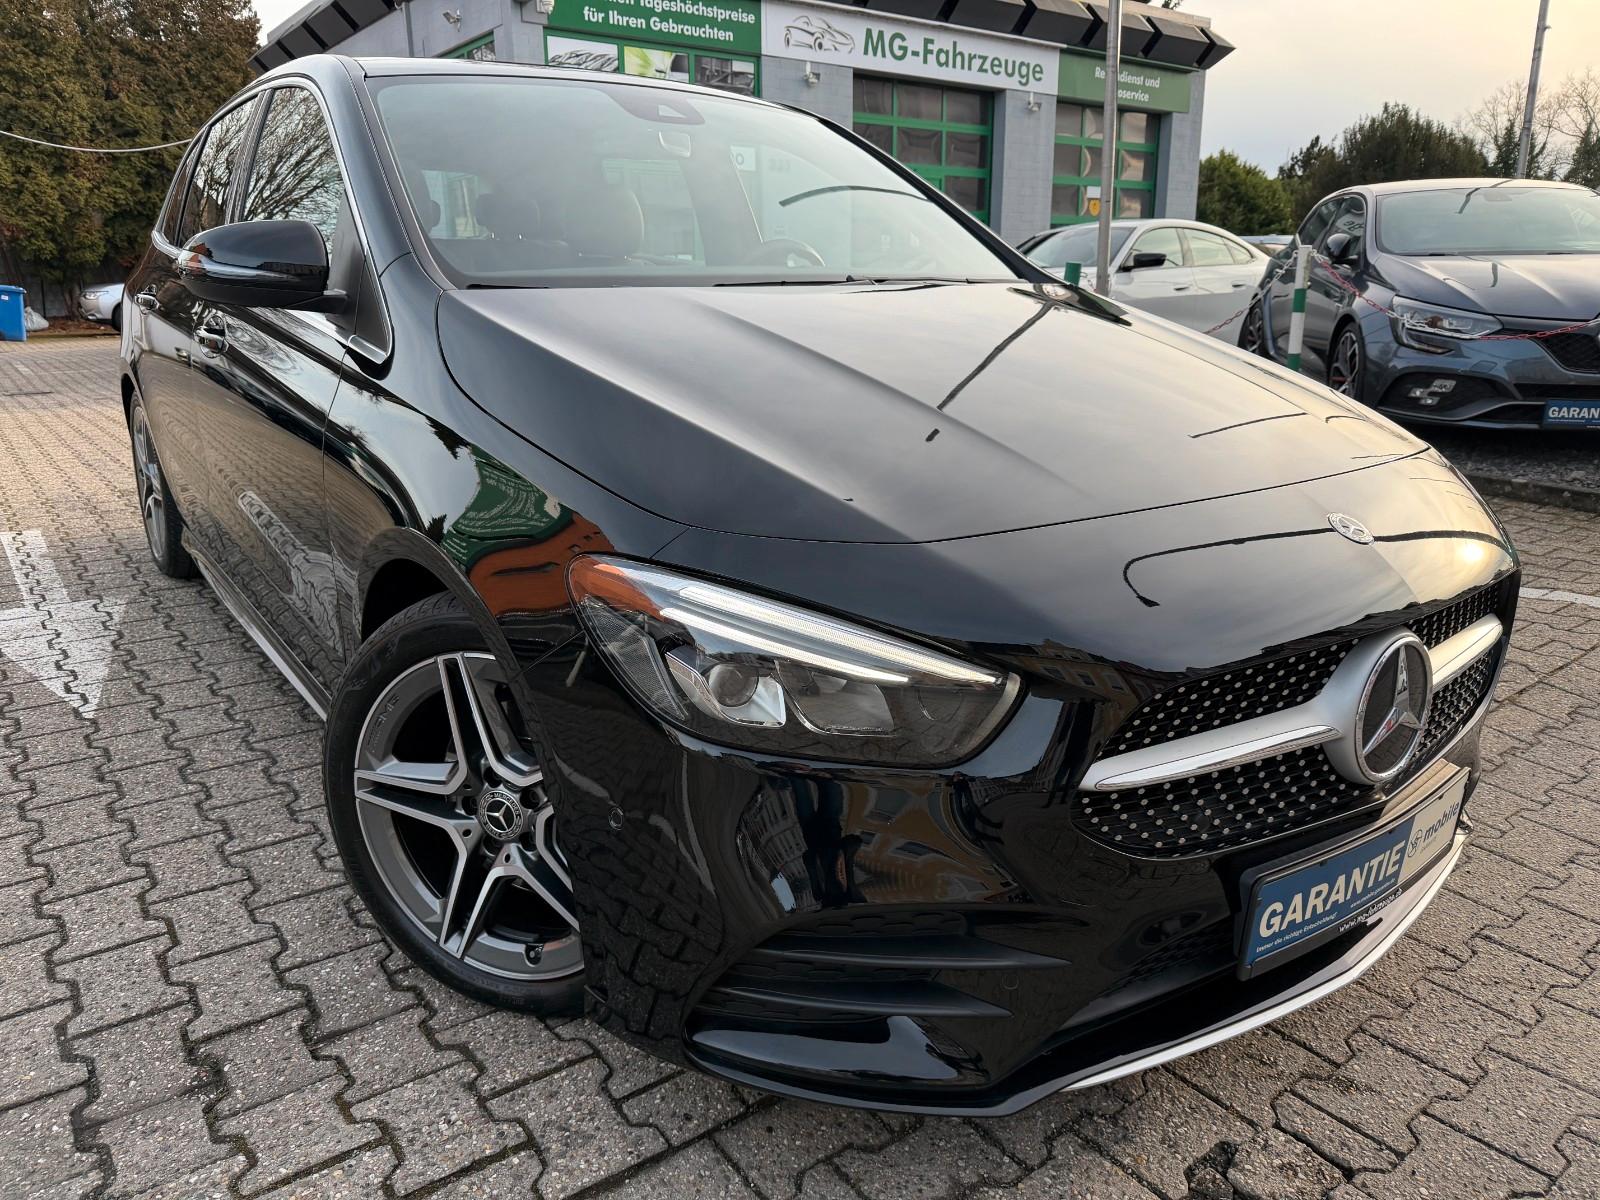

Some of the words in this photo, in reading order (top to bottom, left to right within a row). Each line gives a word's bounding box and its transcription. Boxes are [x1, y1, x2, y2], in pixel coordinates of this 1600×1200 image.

[583, 6, 605, 23] für
[609, 10, 646, 29] Ihren
[650, 17, 733, 41] Gebrauchten
[863, 28, 1044, 86] MG-Fahrzeuge
[1095, 66, 1144, 86] Redienst
[1145, 77, 1160, 88] und
[1423, 802, 1460, 843] mobile
[1259, 840, 1405, 938] GARANTIE
